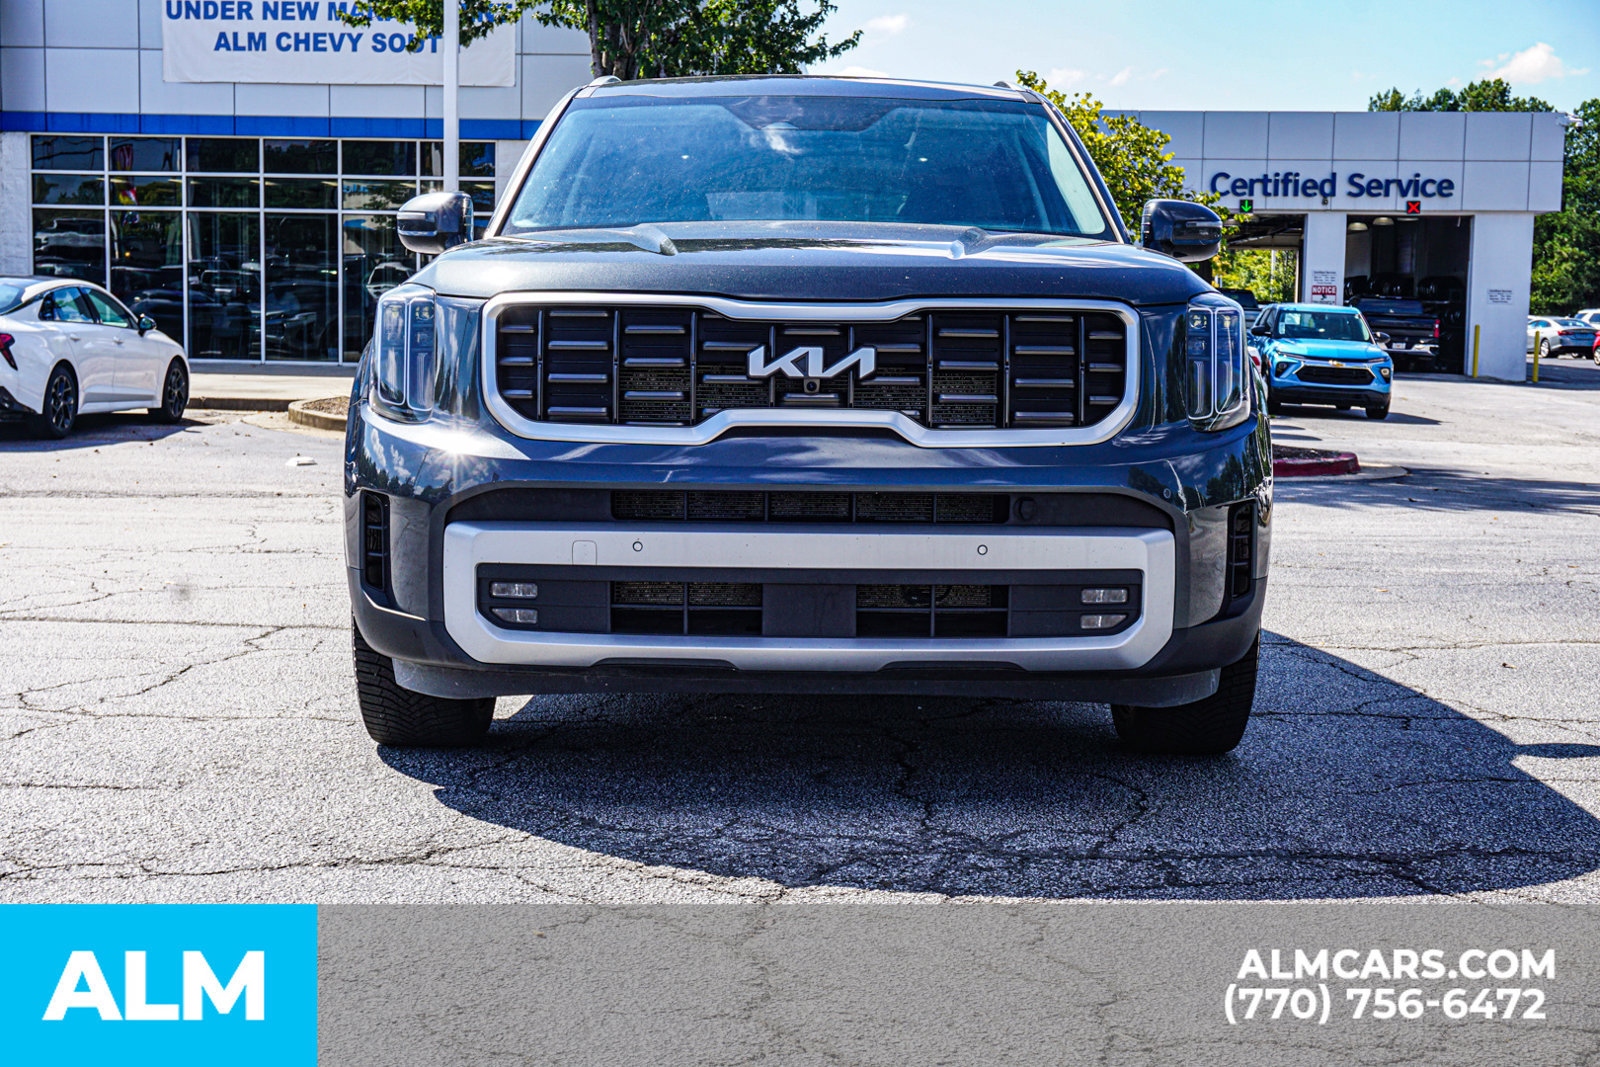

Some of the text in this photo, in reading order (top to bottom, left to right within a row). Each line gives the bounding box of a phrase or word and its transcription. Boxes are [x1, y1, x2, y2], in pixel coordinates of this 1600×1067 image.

[166, 0, 254, 20] UNDER
[262, 0, 320, 21] NEW
[213, 31, 444, 54] ALM CHEVY SOUT
[1210, 171, 1455, 199] Certified Service
[1312, 286, 1336, 294] NOTICE
[748, 346, 876, 379] KIA
